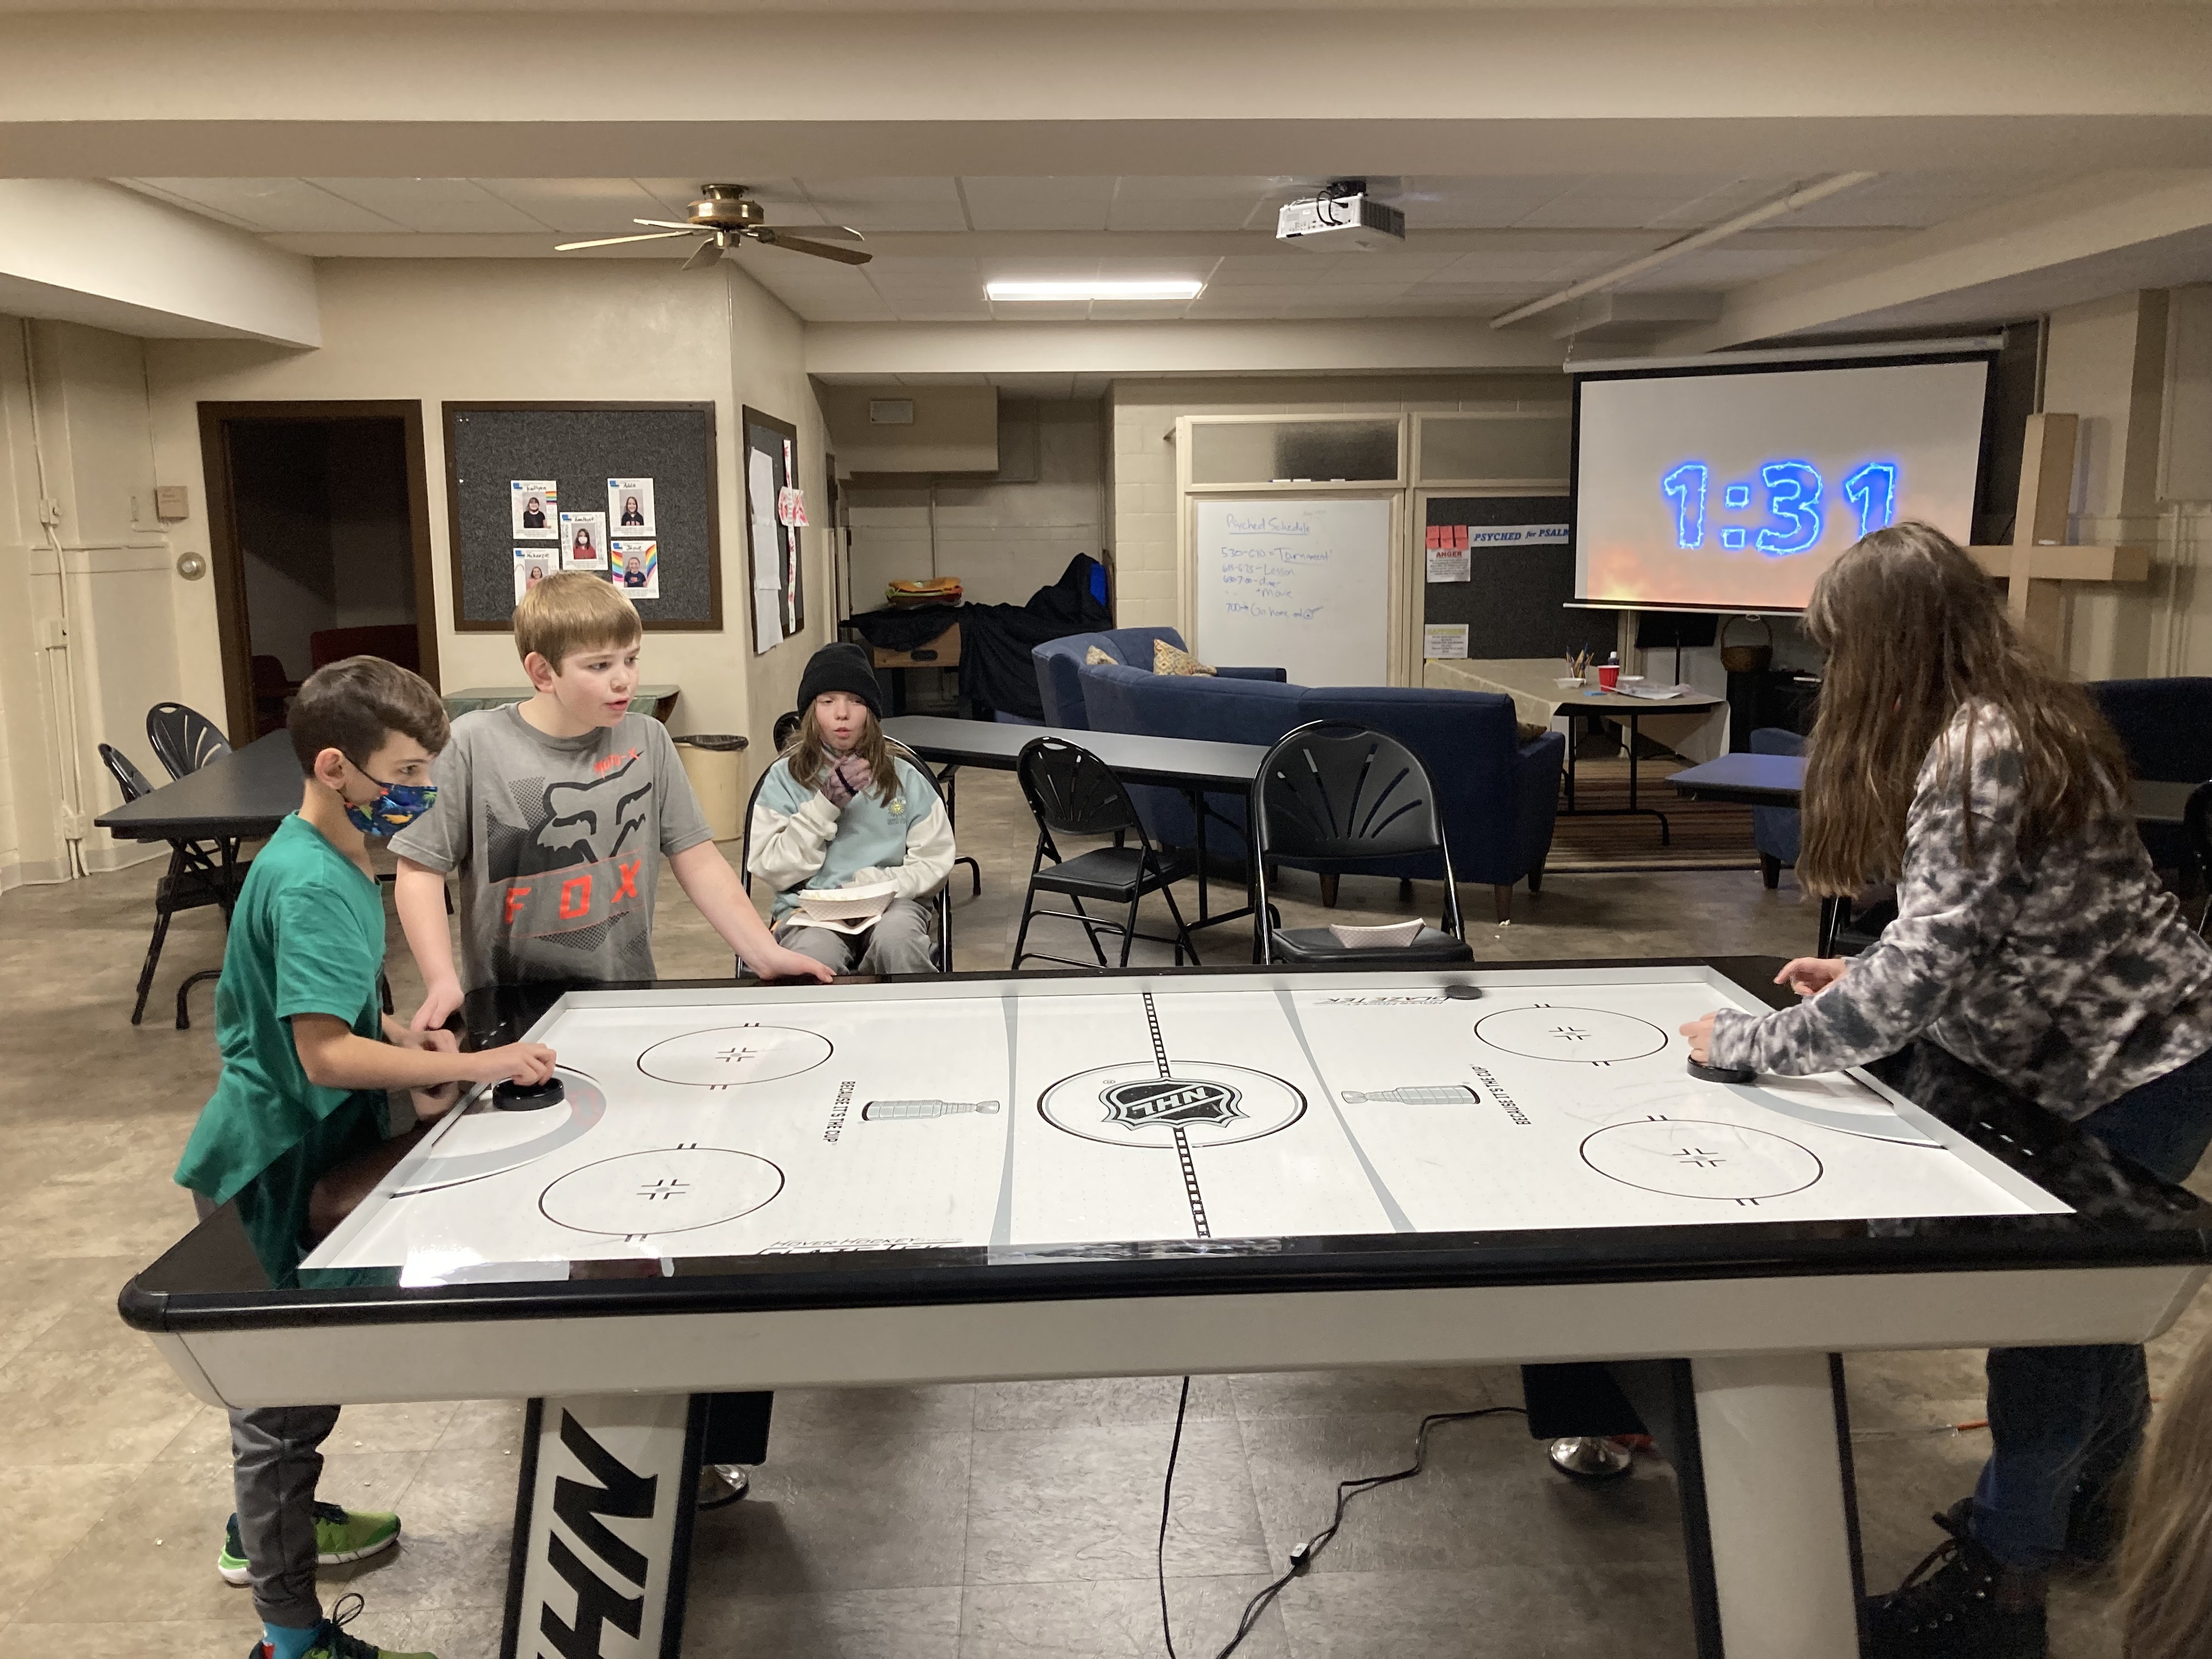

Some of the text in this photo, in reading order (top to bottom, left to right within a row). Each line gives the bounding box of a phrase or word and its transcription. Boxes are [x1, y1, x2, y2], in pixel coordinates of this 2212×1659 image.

[1663, 462, 1896, 555] 1:31
[1227, 514, 1310, 533] Psyched Schedule
[1474, 532, 1522, 541] PSYCHED
[1264, 564, 1294, 575] Lesson
[505, 859, 642, 924] FOX
[1472, 1066, 1491, 1076] CUP
[1480, 1077, 1500, 1087] THE
[834, 1081, 855, 1104] BECAUSE
[1132, 1087, 1208, 1116] NHL
[1498, 1100, 1532, 1125] BECAUSE
[827, 1118, 844, 1129] THE
[823, 1131, 840, 1142] CUP
[537, 1407, 658, 1659] NH
